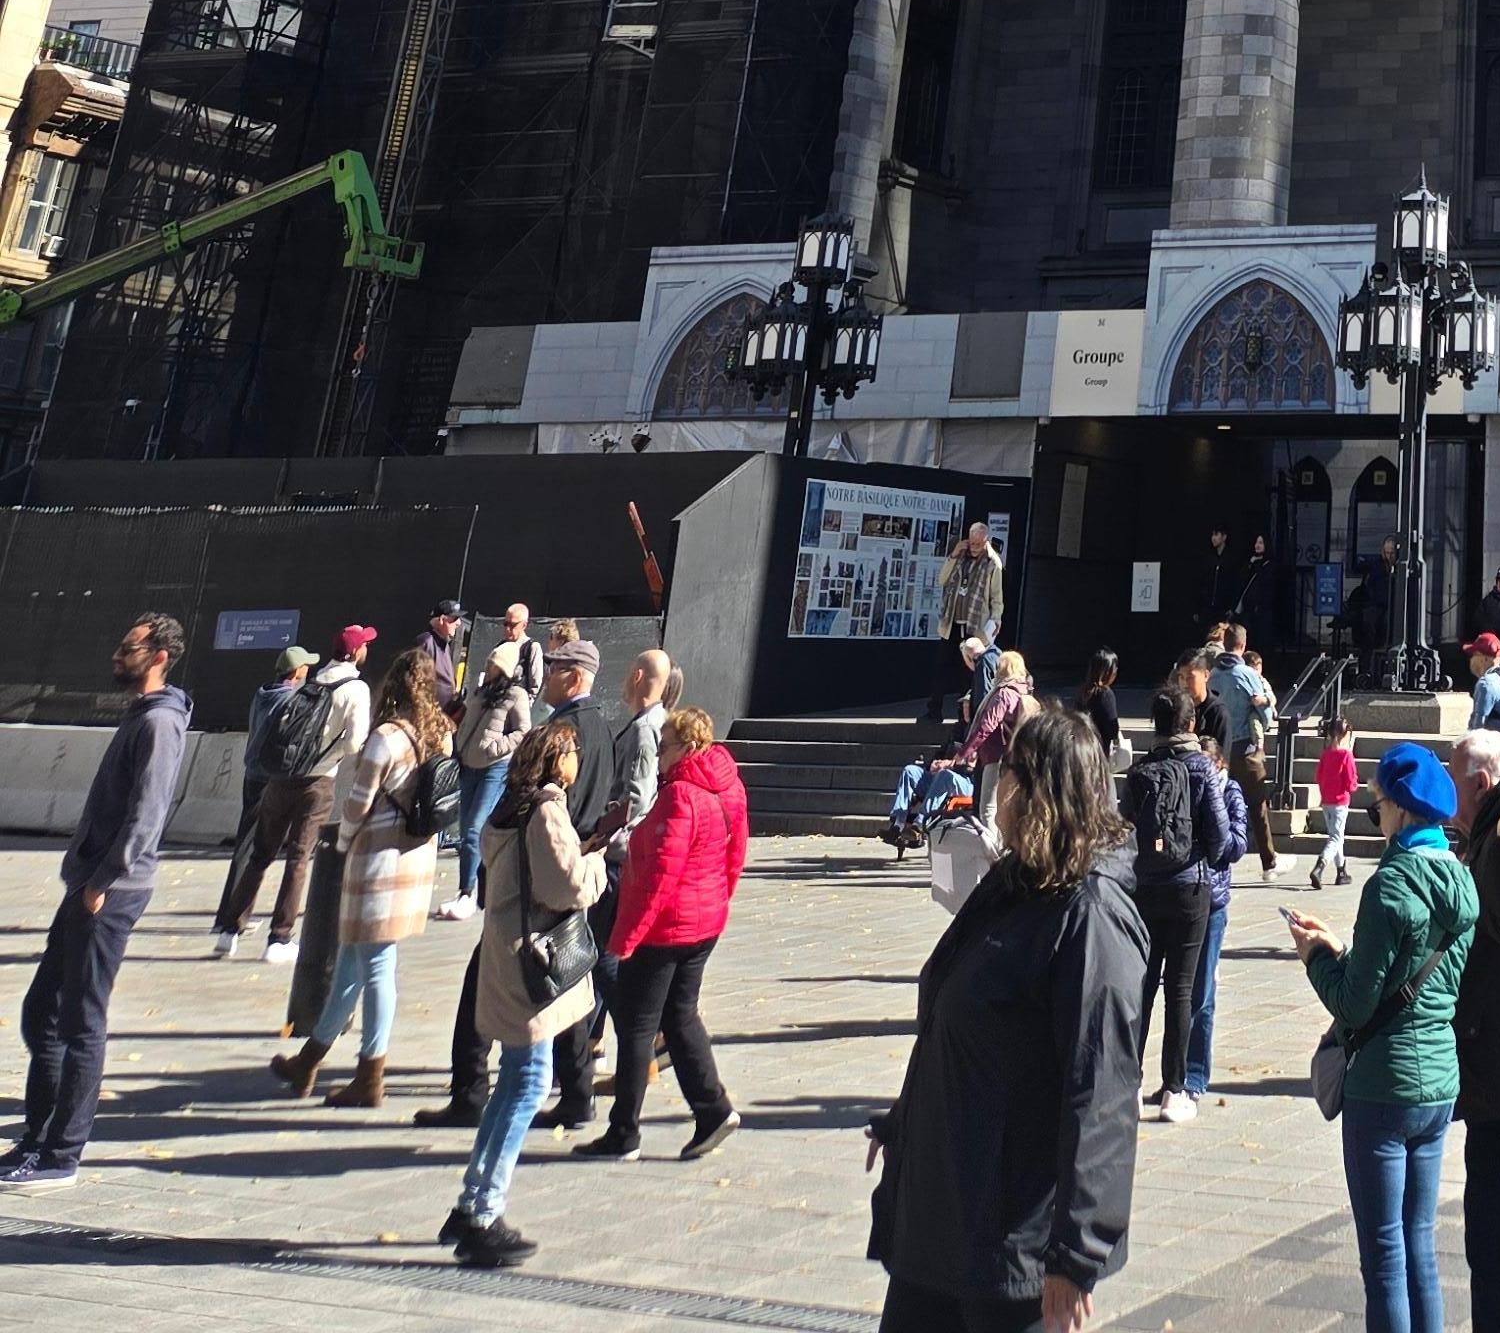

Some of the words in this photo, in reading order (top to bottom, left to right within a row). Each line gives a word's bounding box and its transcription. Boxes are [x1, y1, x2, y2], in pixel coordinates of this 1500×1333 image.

[1073, 349, 1125, 367] Groupe
[1084, 377, 1108, 388] Group
[826, 486, 855, 503] NOTRE
[858, 490, 900, 509] BASILIQUE
